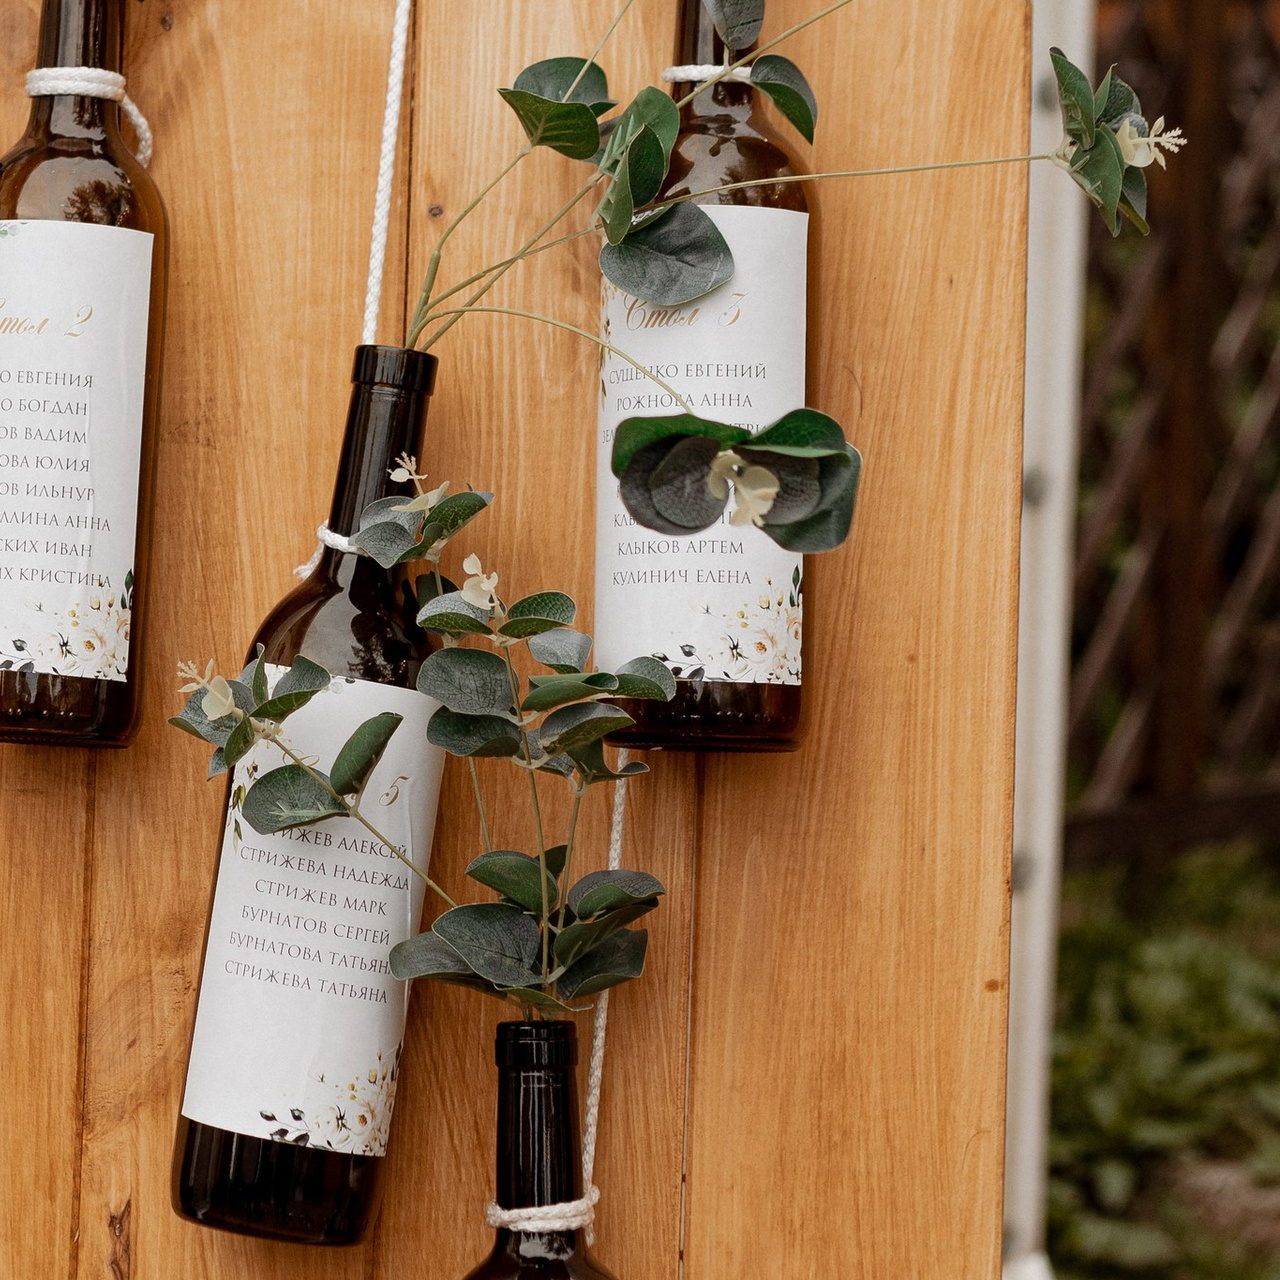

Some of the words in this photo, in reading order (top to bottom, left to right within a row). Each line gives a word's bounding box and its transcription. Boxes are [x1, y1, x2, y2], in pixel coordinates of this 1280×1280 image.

[718, 291, 750, 327] 3
[64, 304, 93, 338] 2
[17, 370, 93, 389] ЕВГЕНИЯ
[685, 362, 766, 379] ЕВГЕНИЙ
[18, 399, 87, 416] БОГДАН
[700, 393, 753, 408] АННА
[24, 427, 87, 444] ВАДИМ
[35, 455, 90, 472] ЮЛИЯ
[26, 483, 95, 502] ИЛЬНУР
[64, 515, 111, 532] АННА
[45, 541, 92, 558] ИВАН
[618, 540, 680, 556] КЛЫКОВ
[686, 540, 745, 555] АРТЕМ
[19, 567, 111, 588] КРИСТИНА
[612, 570, 688, 586] КУЛИНИЧ
[696, 569, 752, 585] ЕЛЕНА
[379, 775, 410, 807] 5
[240, 845, 326, 876] СТРИЖЕВА
[333, 864, 409, 891] НАДЕЖДА
[255, 879, 338, 907] СТРИЖЕВ
[343, 896, 388, 916] МАРК
[241, 904, 327, 934] БУРНАТОВ
[333, 923, 390, 946] СЕРГЕЙ
[229, 931, 322, 963] БУРНАТОВА
[329, 951, 391, 975] ТАТЬЯН
[224, 960, 311, 990] СТРИЖЕВА
[318, 979, 388, 1004] ТАТЬЯНА
